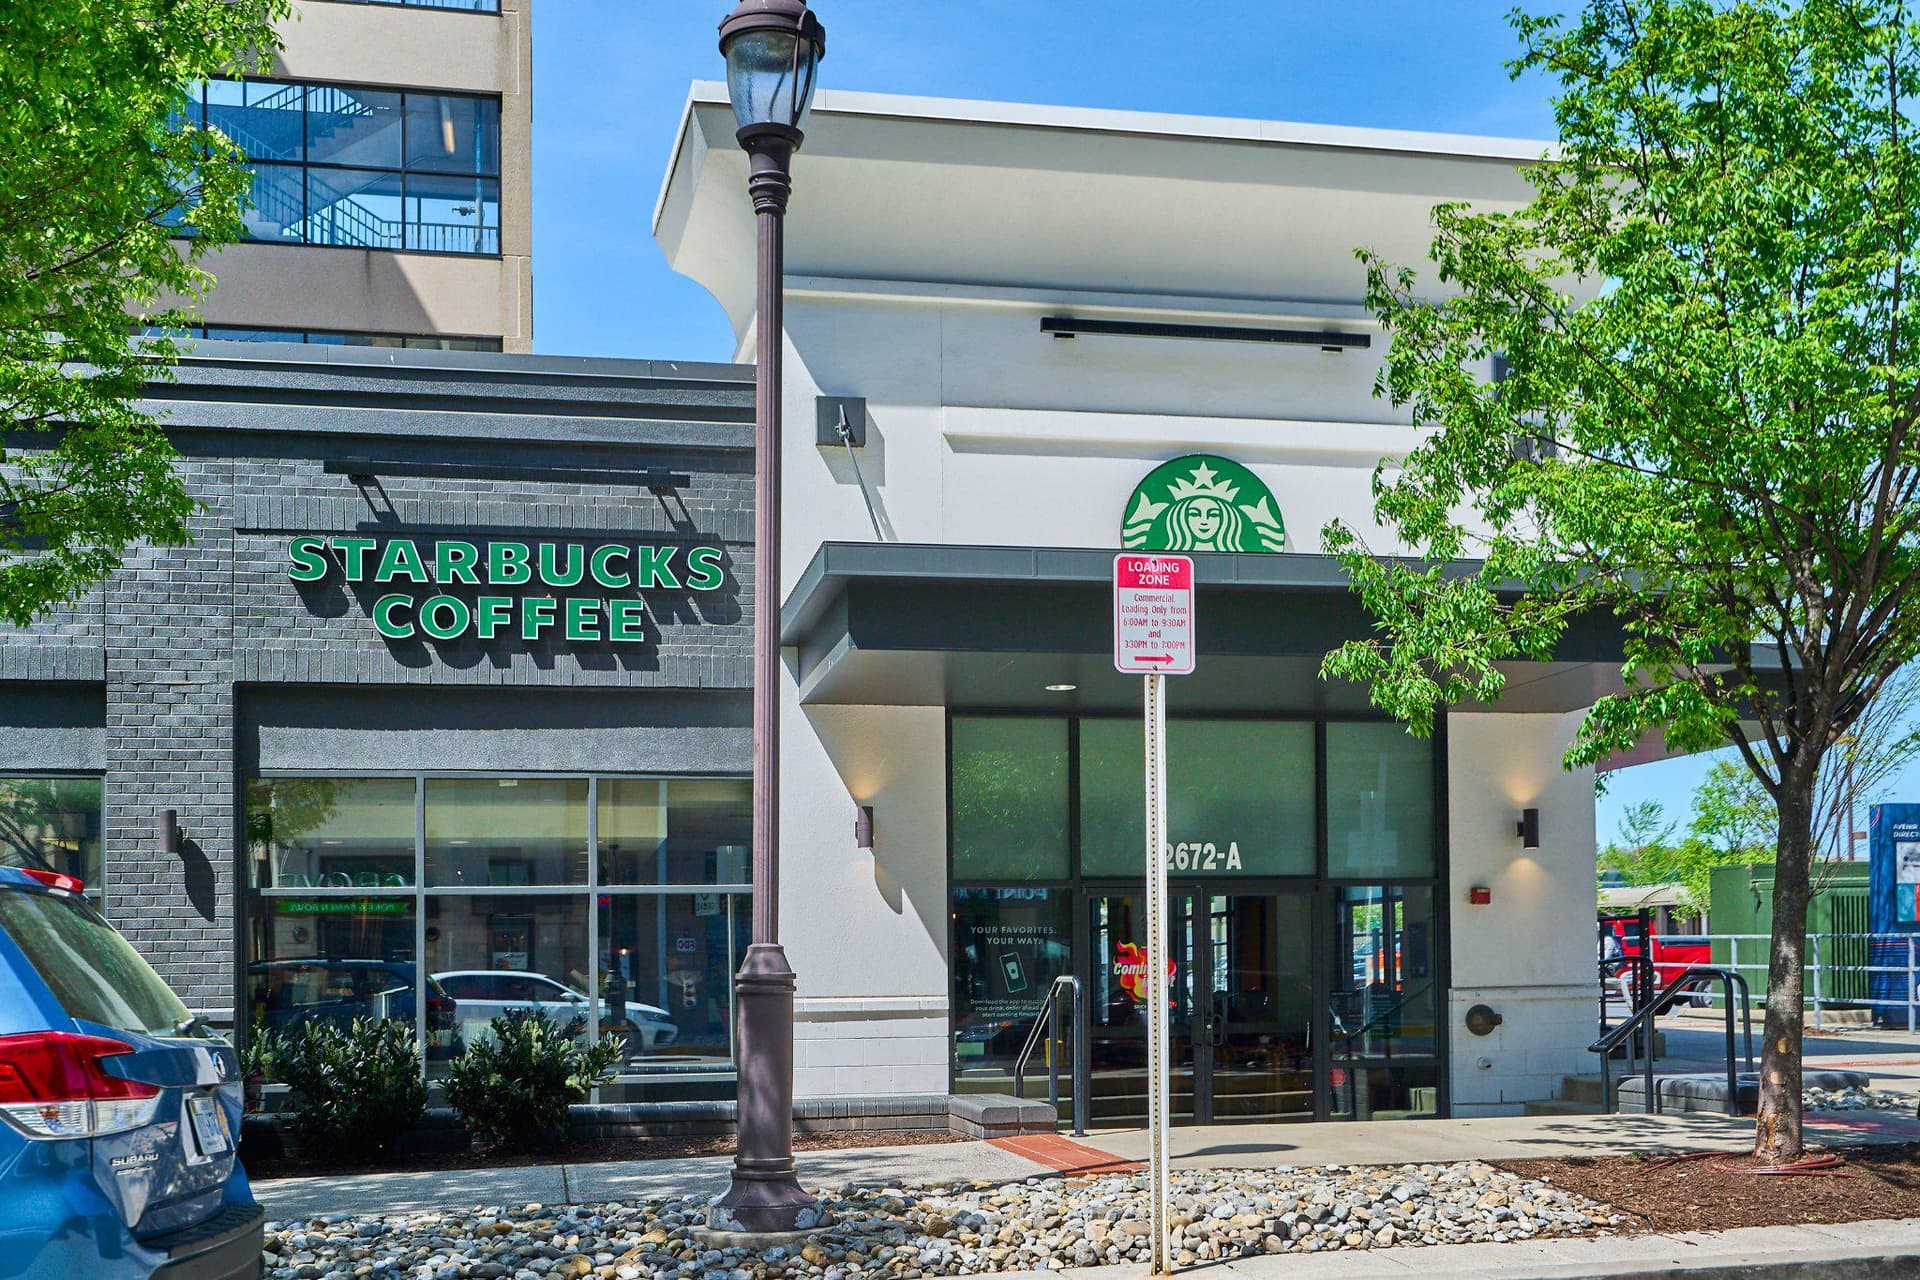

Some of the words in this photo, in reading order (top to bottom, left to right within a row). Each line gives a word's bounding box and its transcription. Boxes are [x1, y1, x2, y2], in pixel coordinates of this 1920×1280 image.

[287, 536, 725, 591] STARBUCKS
[1128, 561, 1180, 573] LOADING
[1138, 574, 1170, 585] ZONE
[1134, 593, 1175, 603] Commercial
[1121, 605, 1148, 616] Loading
[1151, 605, 1167, 616] Only
[1170, 606, 1187, 615] from
[372, 593, 645, 642] COFFEE
[1123, 617, 1148, 627] 6:00AM
[1151, 618, 1159, 627] to
[1161, 618, 1186, 628] 9:30AM
[1148, 629, 1161, 638] and
[1124, 640, 1148, 649] 3:30PM
[1150, 640, 1158, 649] to
[1161, 640, 1185, 650] 7:00PM
[1166, 841, 1242, 870] 2672-A
[970, 926, 998, 935] YOUR
[1001, 926, 1057, 935] FAVORITES.
[987, 937, 1014, 945] YOUR
[1017, 937, 1041, 945] WAY.
[111, 1152, 159, 1167] SUBARU
